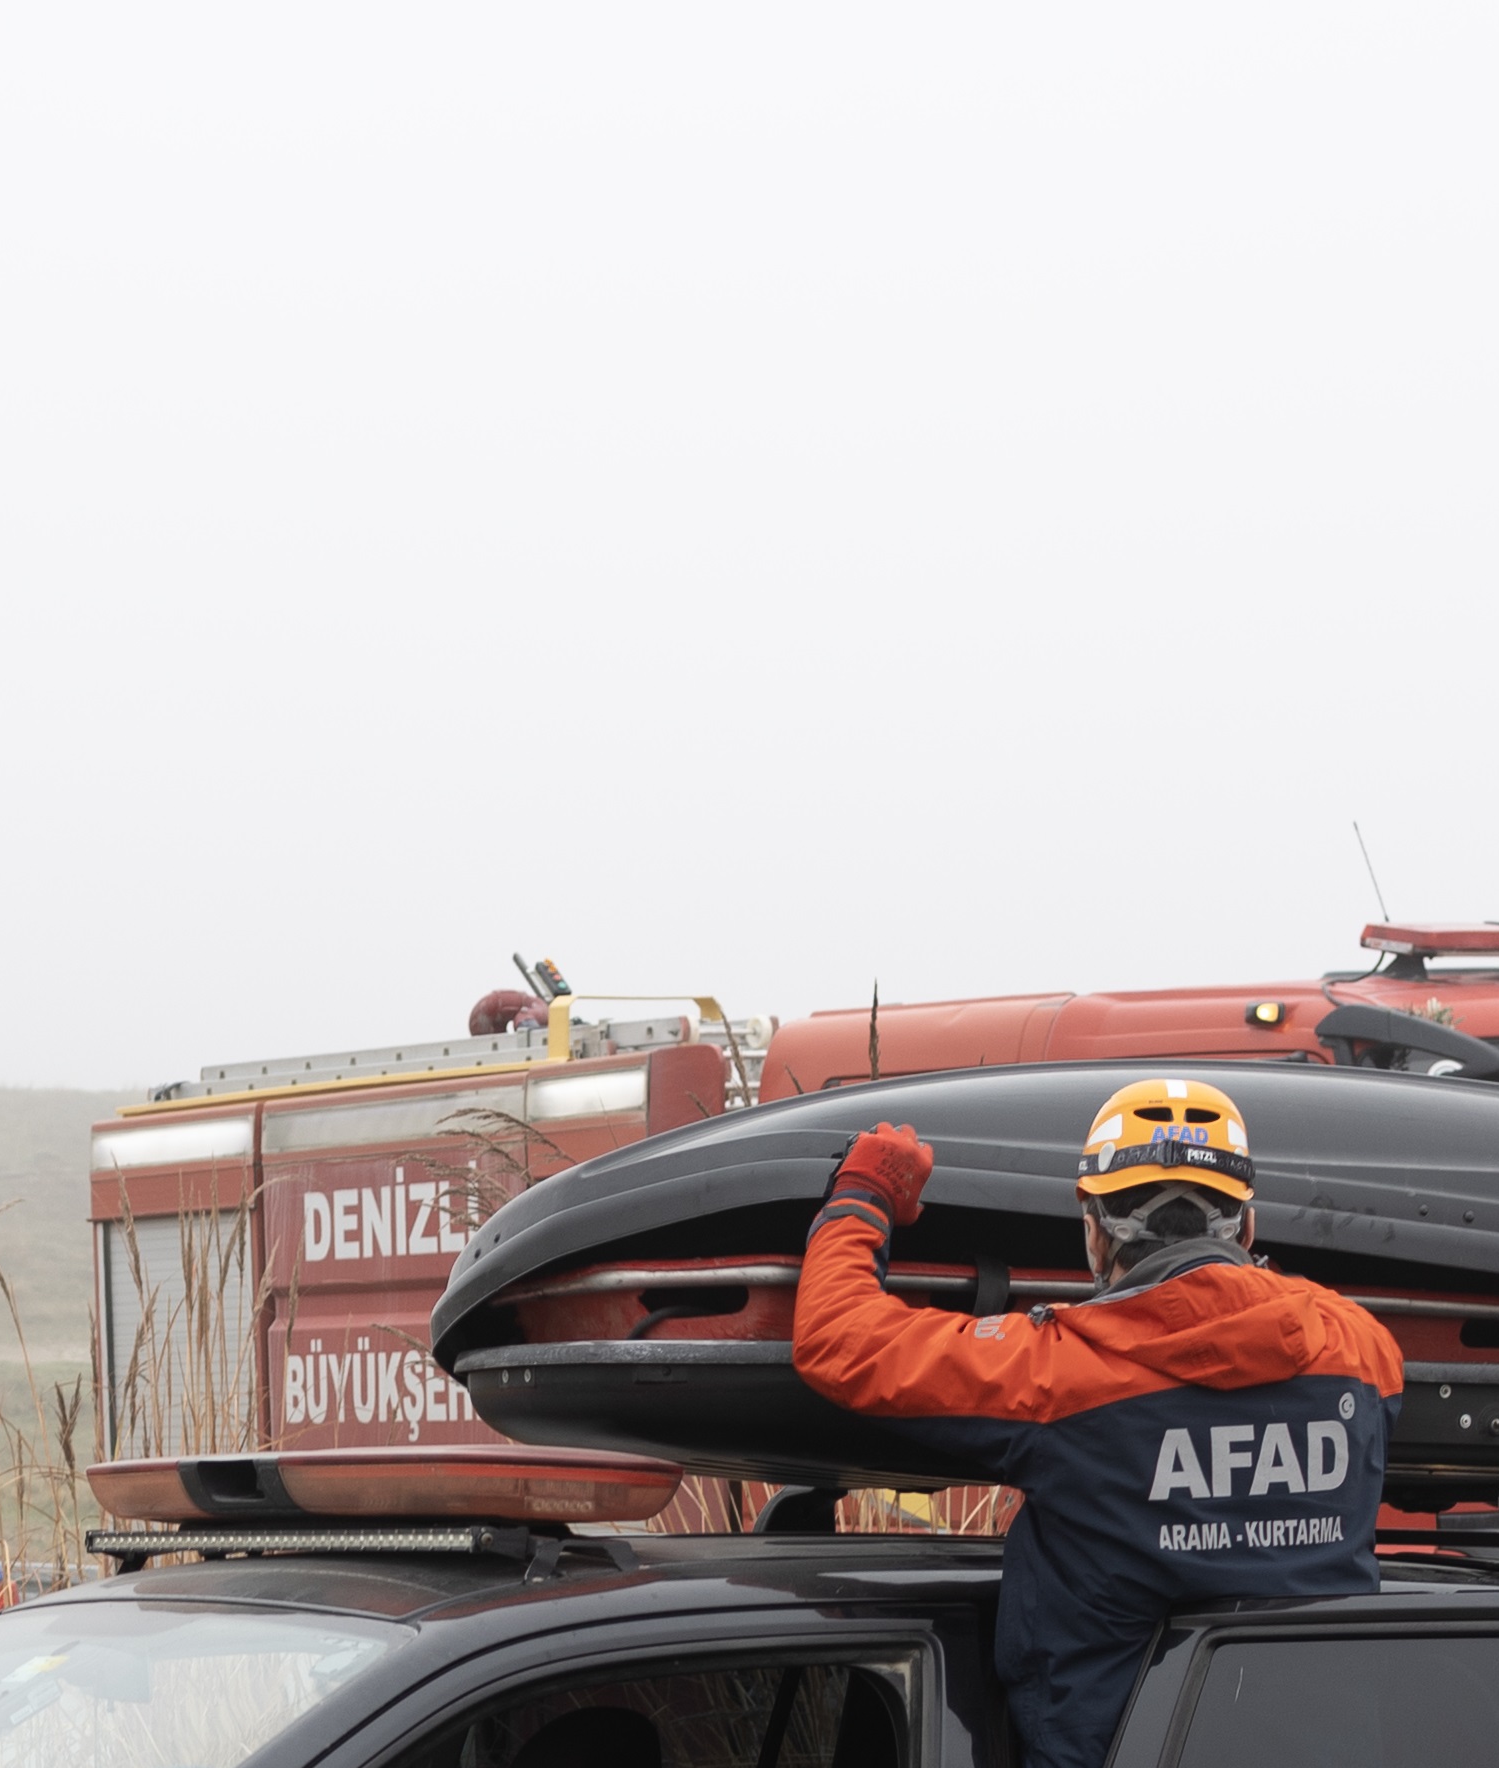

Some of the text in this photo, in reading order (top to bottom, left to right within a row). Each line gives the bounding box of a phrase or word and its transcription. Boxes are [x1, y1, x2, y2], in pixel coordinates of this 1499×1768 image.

[1151, 1126, 1209, 1146] AFAD
[285, 1336, 483, 1442] BÜYÜKŞEH
[1148, 1420, 1350, 1501] AFAD
[1159, 1522, 1232, 1551] ARAMA
[1245, 1515, 1344, 1548] KURTARMA
